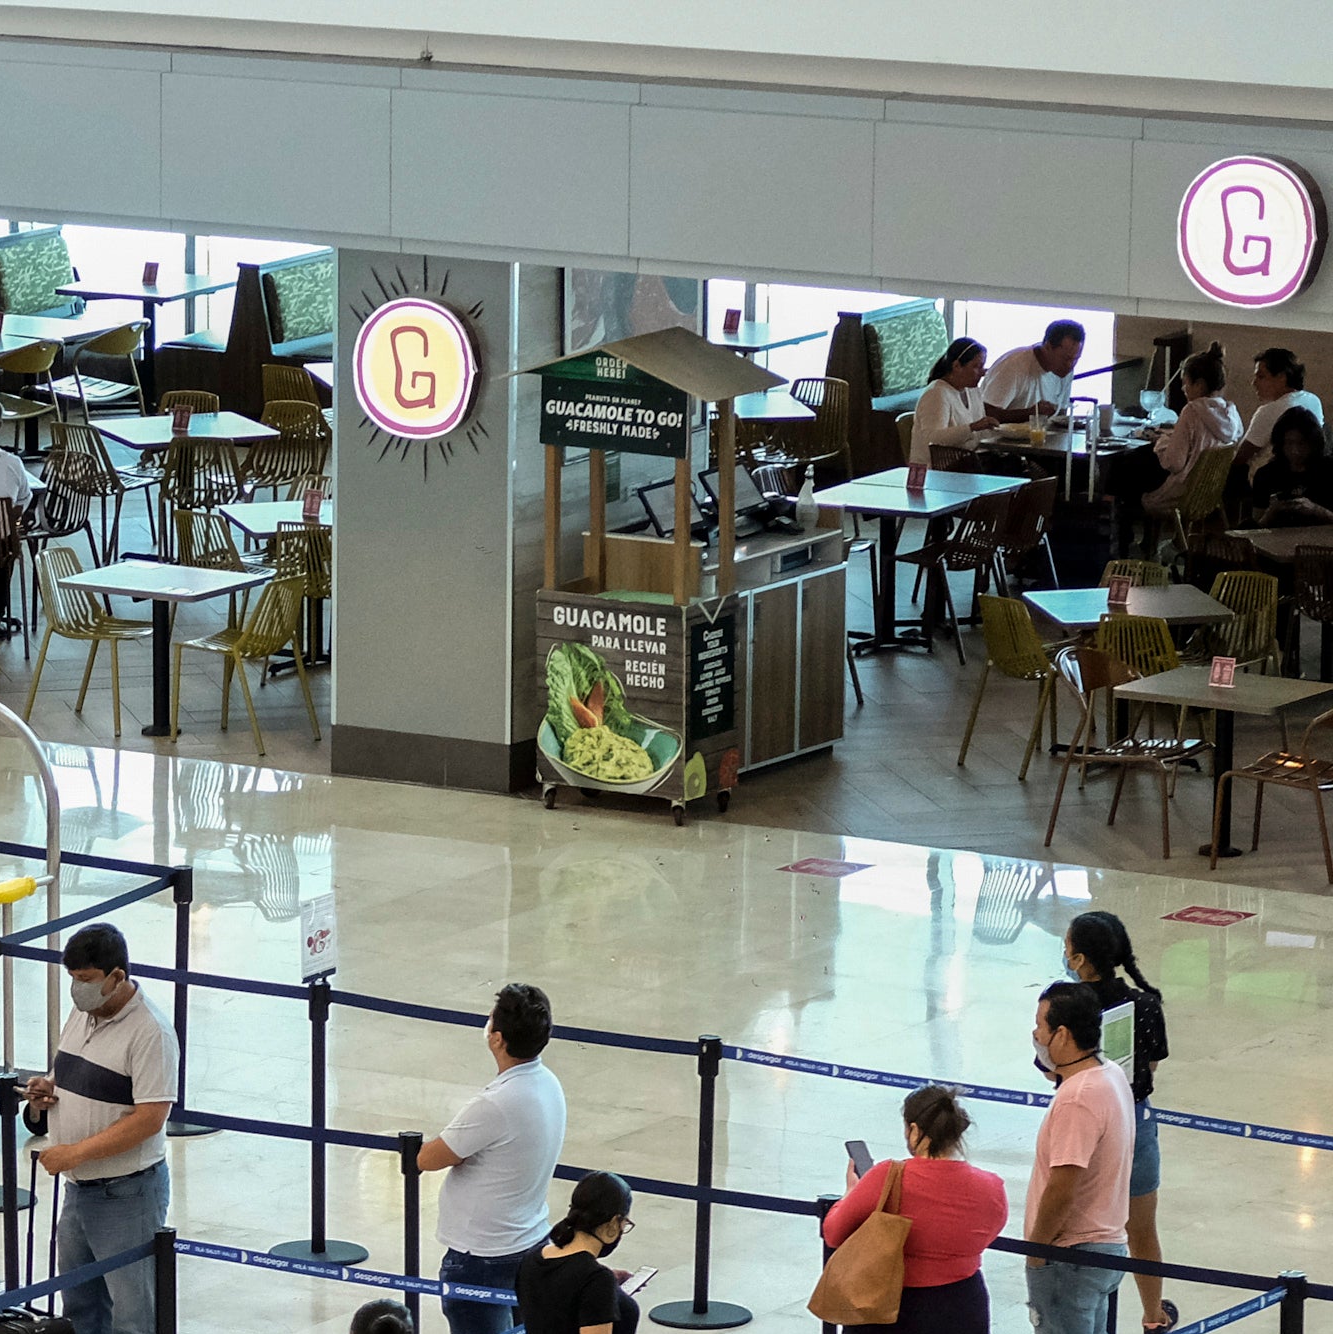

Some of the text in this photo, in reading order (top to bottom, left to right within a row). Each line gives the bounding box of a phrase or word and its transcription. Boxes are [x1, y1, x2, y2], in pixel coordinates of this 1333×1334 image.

[390, 325, 436, 409] G
[545, 399, 683, 428] GUACAMOLE TO GO!
[573, 420, 652, 440] FRESHLY MADE
[553, 606, 667, 637] GUACAMOLE
[592, 634, 667, 656] PARA LLEVAR
[625, 659, 666, 676] RECIÉN
[626, 674, 665, 690] HECHO
